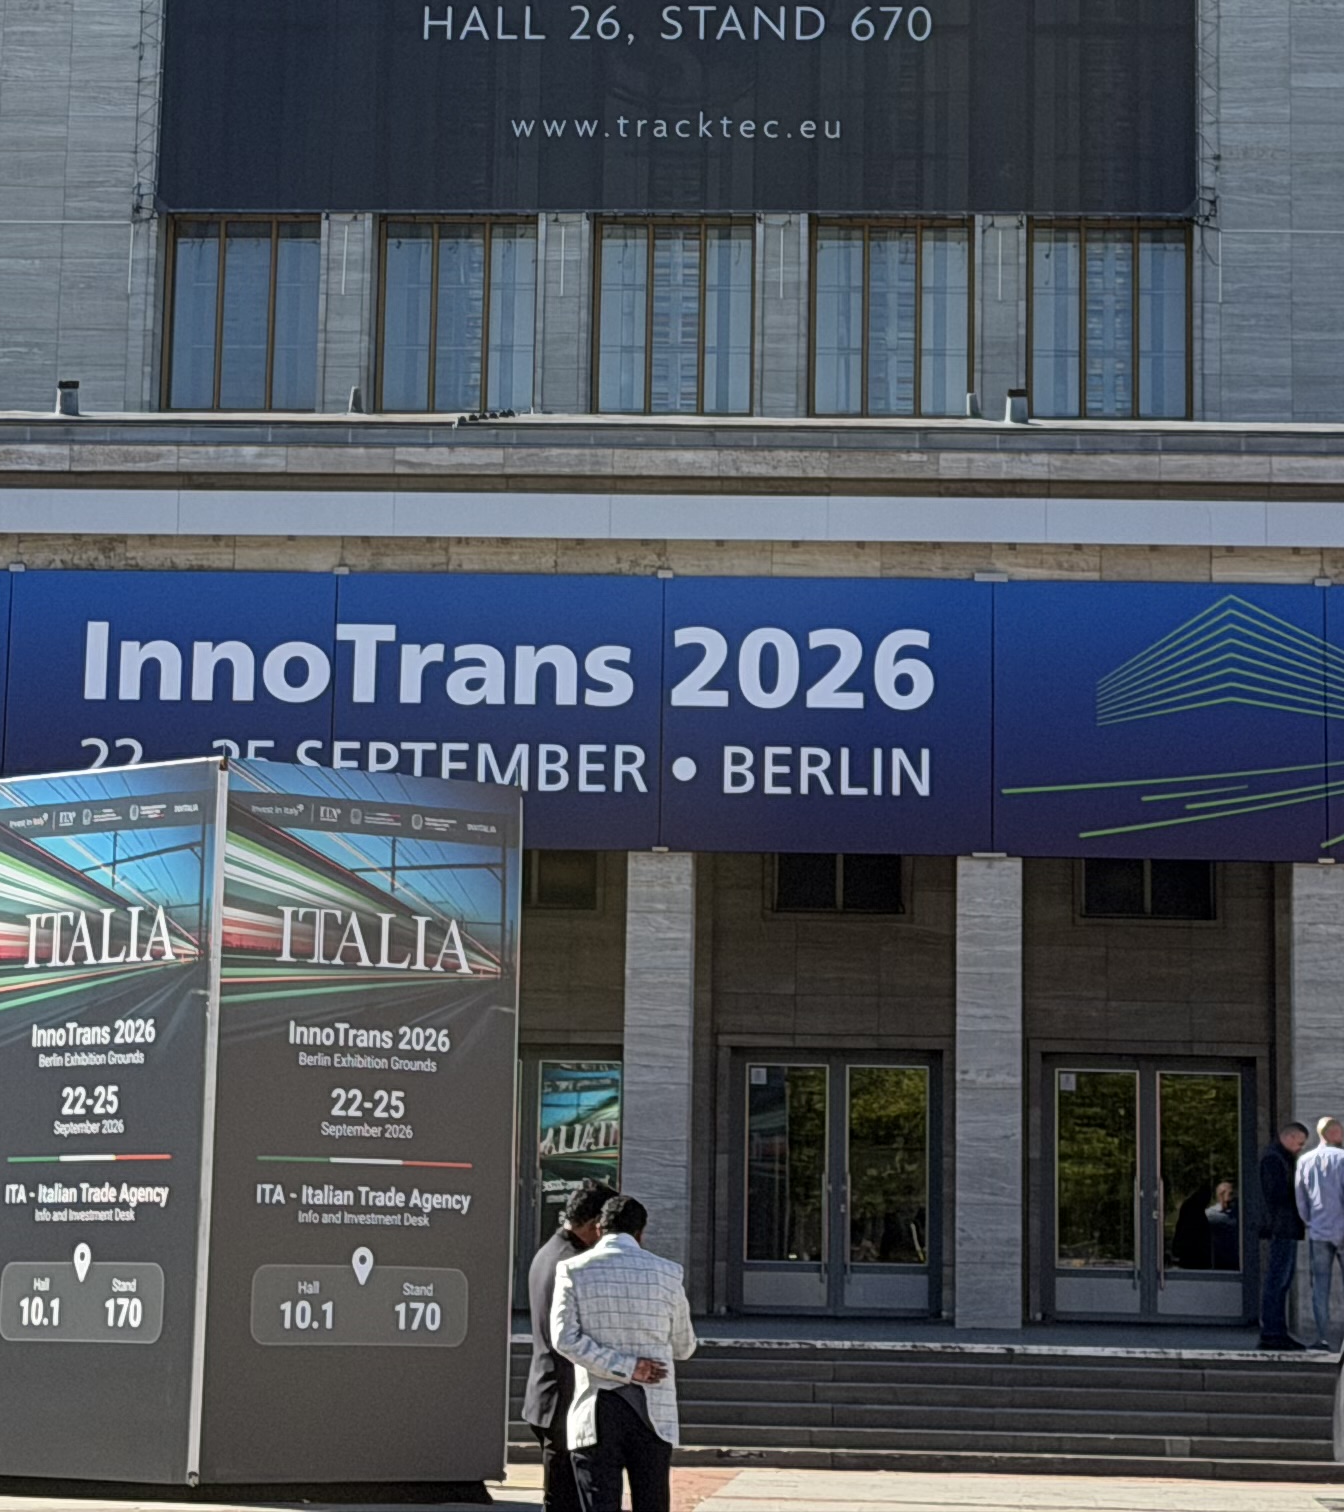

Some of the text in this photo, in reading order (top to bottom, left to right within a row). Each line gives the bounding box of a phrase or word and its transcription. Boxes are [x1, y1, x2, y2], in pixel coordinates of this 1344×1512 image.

[423, 5, 933, 46] HALL 26, STAND 670
[511, 111, 842, 139] www.tracktec.eu
[83, 620, 936, 711] InnoTrans 2026
[296, 740, 649, 793] SEPTEMBER
[723, 745, 932, 797] BERLIN
[23, 905, 175, 968] ITALIA
[275, 906, 474, 974] ITALIA
[31, 1018, 156, 1048] InnoTrans 2026
[288, 1020, 451, 1053] InnoTrans 2026
[38, 1049, 145, 1068] Berlin Exhibition Grounds
[298, 1051, 438, 1073] Berlin Exhibition Grounds
[61, 1085, 119, 1116] 22-25
[330, 1088, 405, 1119] 22-25
[53, 1118, 125, 1138] September 2026
[320, 1121, 414, 1139] September 2026
[5, 1184, 27, 1204] ITA
[38, 1182, 78, 1204] Italian
[79, 1182, 117, 1204] Trade
[118, 1182, 169, 1208] Agency
[256, 1183, 286, 1205] ITA
[301, 1184, 354, 1206] Italian
[357, 1186, 406, 1208] Trade
[408, 1188, 471, 1215] Agency
[34, 1207, 136, 1222] Info and Investment Desk
[297, 1209, 430, 1227] Info and Investment Desk
[33, 1277, 137, 1293] Hall Stand
[297, 1280, 434, 1297] Hall Stand
[19, 1296, 143, 1328] 10.1 170
[279, 1300, 442, 1332] 10.1 170
